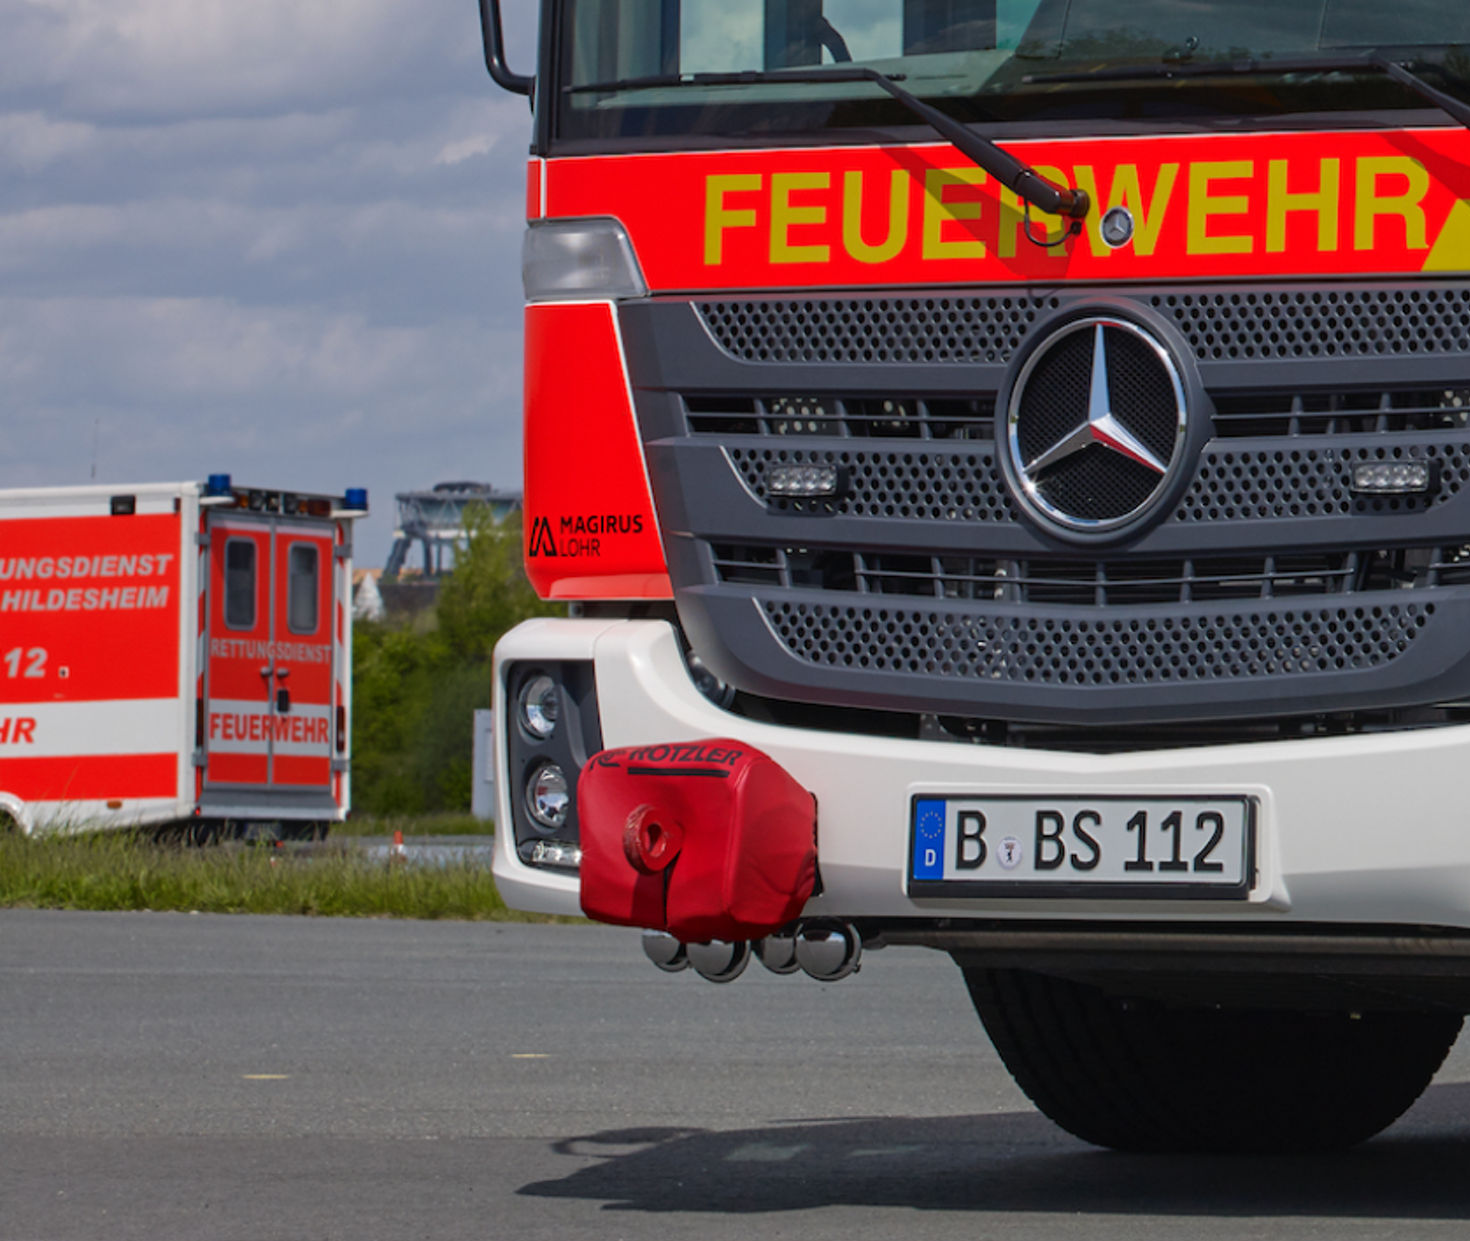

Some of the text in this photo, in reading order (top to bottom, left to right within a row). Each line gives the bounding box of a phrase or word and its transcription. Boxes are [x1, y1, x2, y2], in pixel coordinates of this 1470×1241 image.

[704, 156, 1430, 266] FEUERWEHR
[560, 515, 643, 534] MAGIRUS
[560, 538, 600, 557] LOHR
[0, 554, 173, 581] UNGSDIENST
[1, 585, 170, 611] HILDESHEIM
[3, 646, 48, 678] 12
[209, 638, 332, 664] RETTUNGSDIENST
[209, 713, 329, 744] FEUERWEHR
[628, 744, 743, 766] ROTZLER
[956, 810, 1225, 872] B BS 112
[924, 849, 936, 867] D
